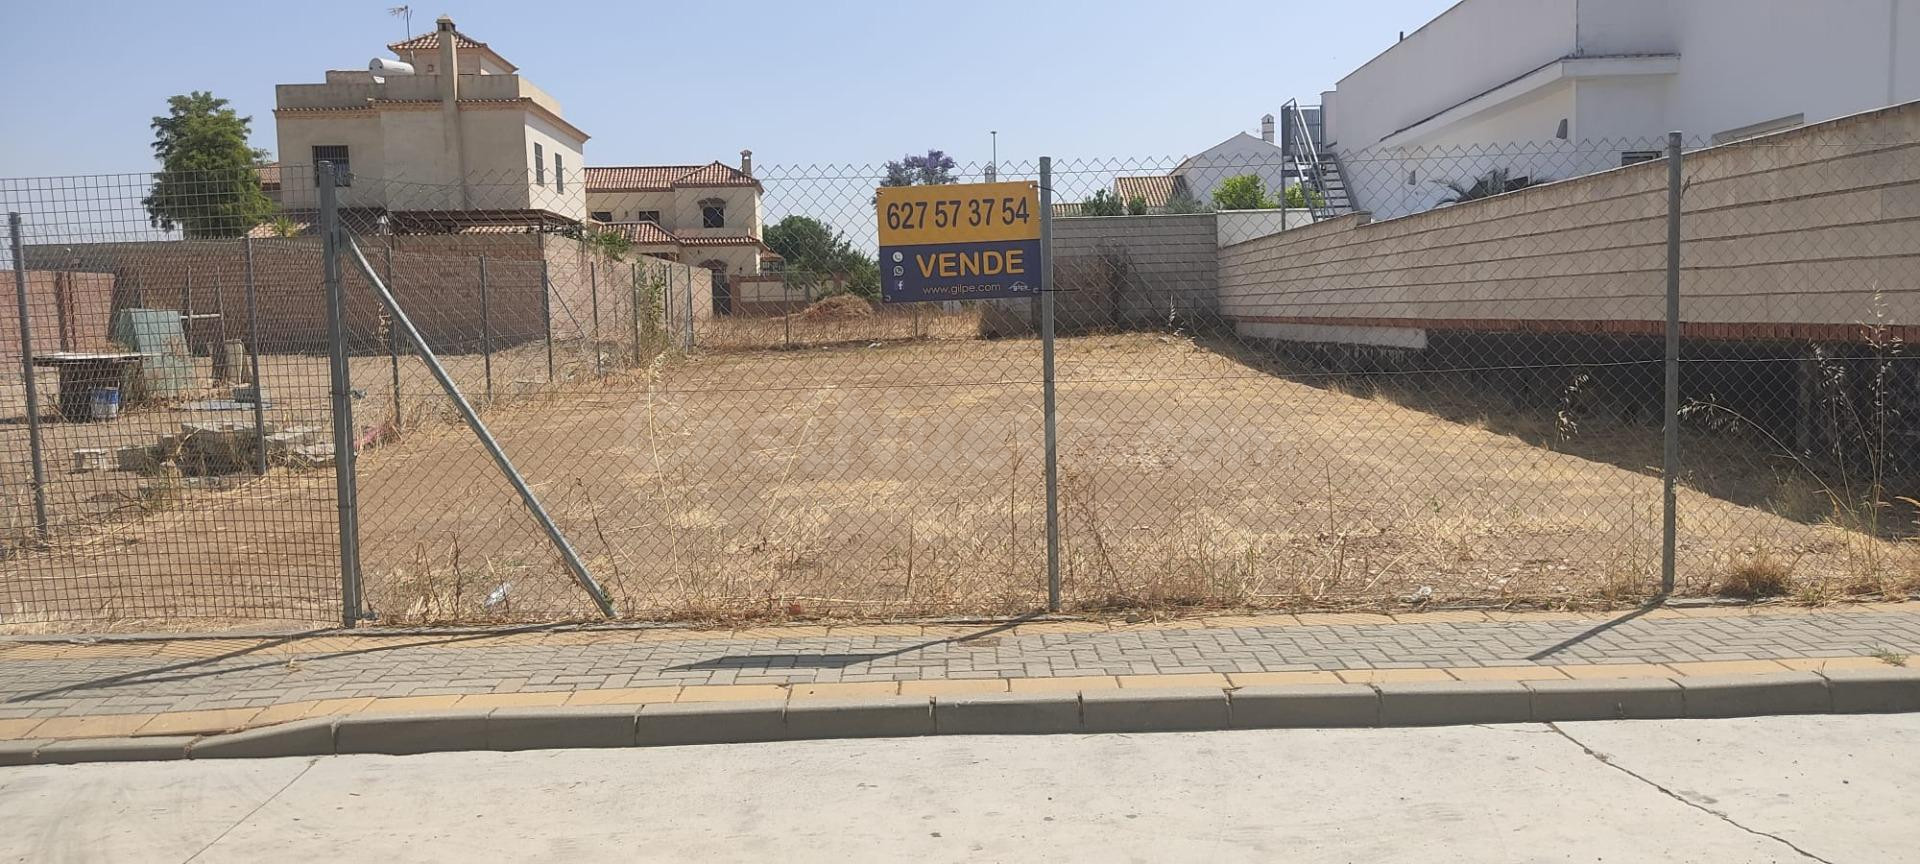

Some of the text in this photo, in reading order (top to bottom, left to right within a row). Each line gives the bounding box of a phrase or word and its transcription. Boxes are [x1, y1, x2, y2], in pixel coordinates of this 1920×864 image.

[887, 197, 1030, 230] 627 57 37 54
[916, 250, 1025, 278] VENDE
[922, 284, 1001, 296] www.gilpe.com
